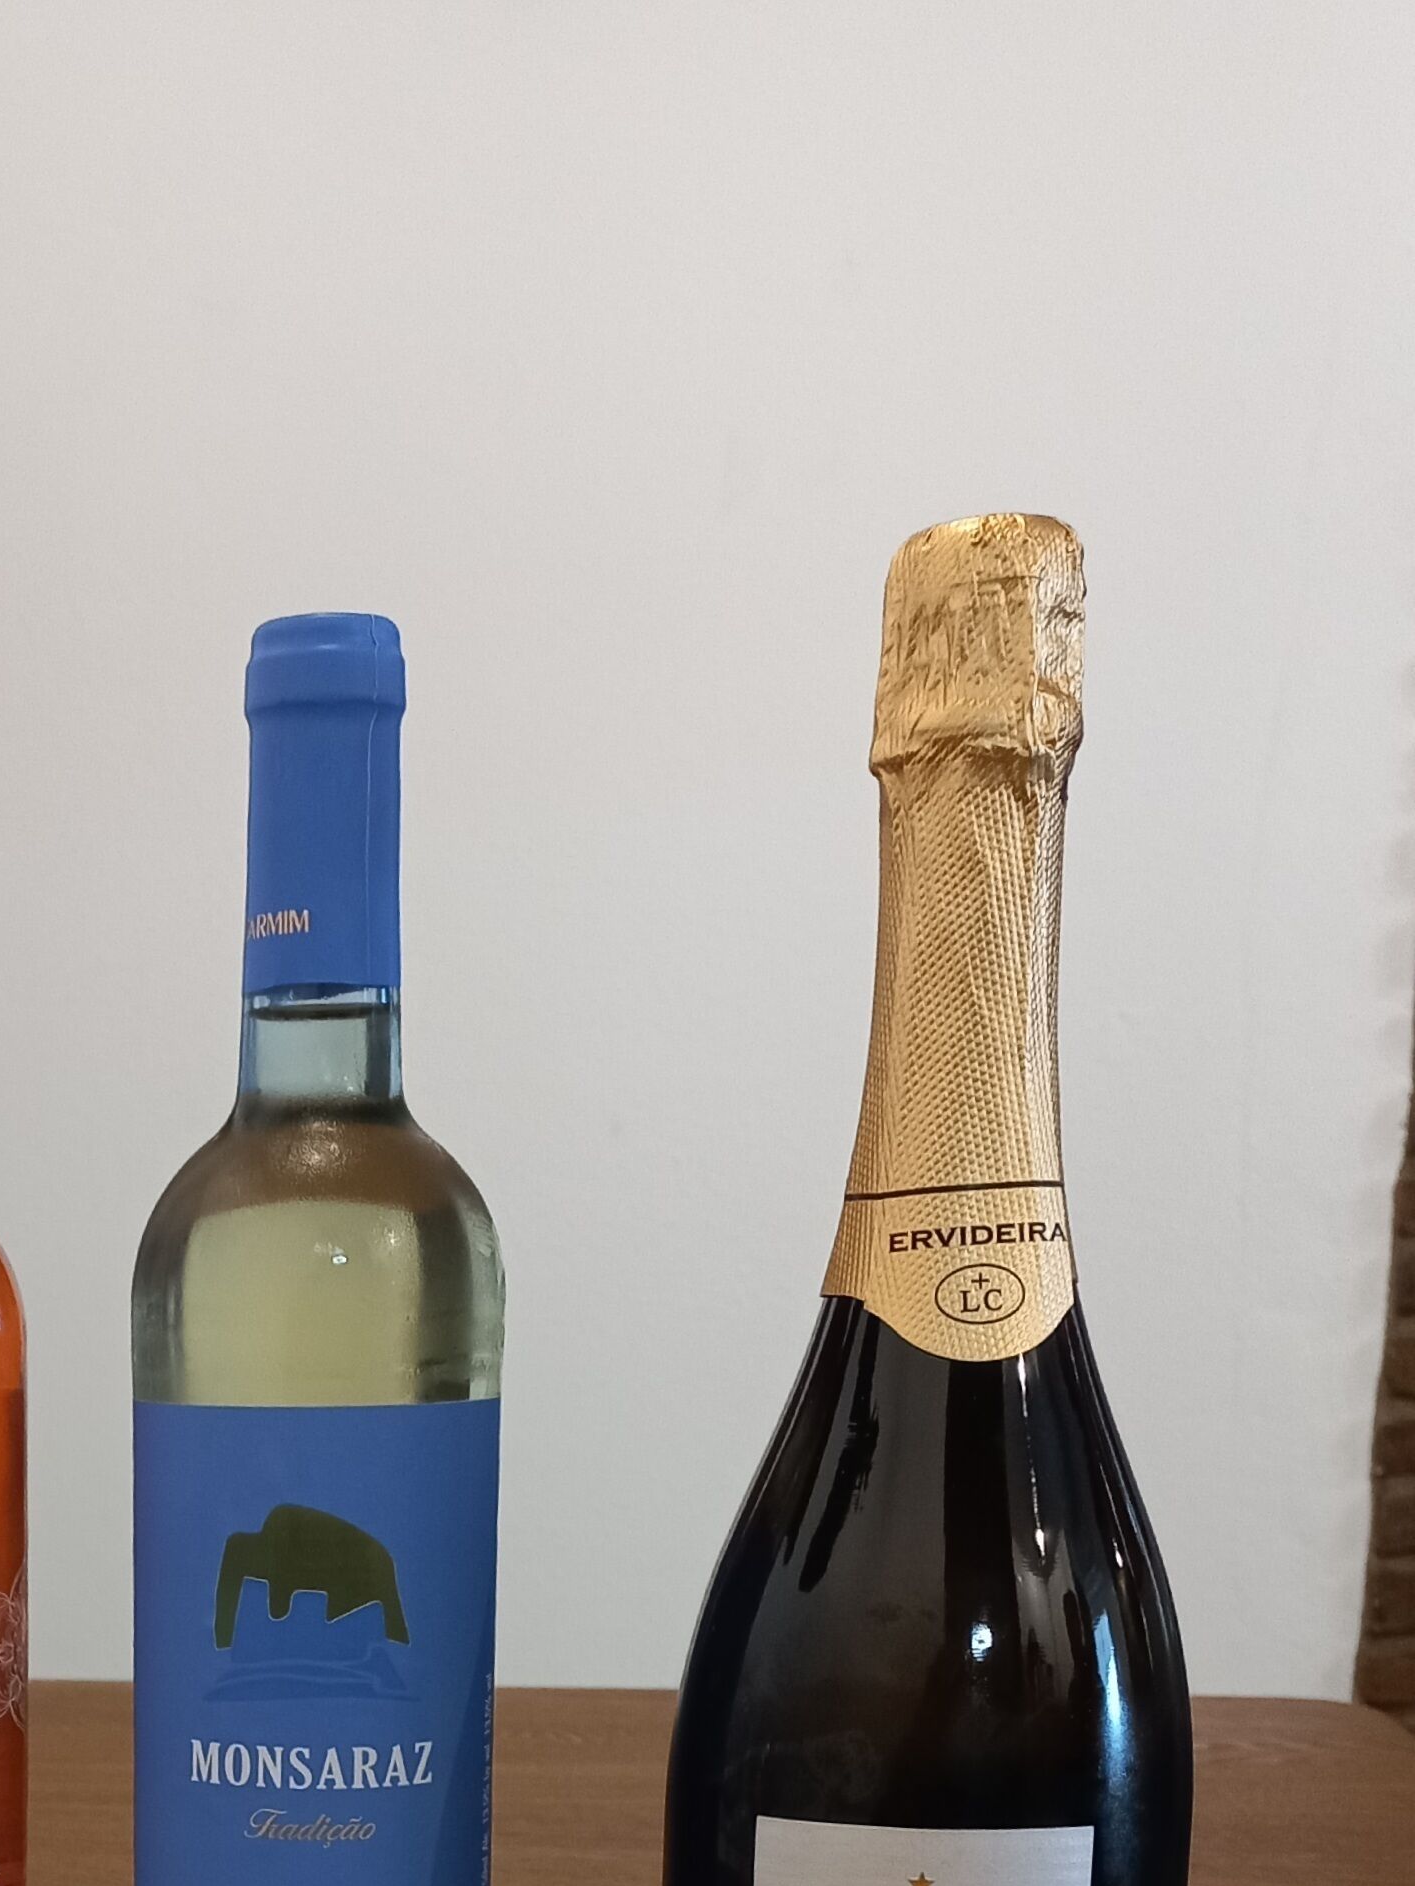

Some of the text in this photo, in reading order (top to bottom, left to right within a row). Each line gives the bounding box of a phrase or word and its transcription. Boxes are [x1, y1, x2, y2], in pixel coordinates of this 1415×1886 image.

[247, 909, 309, 940] ARMIM
[888, 1221, 1067, 1254] ERVIDEIRA
[189, 1738, 435, 1791] MONSARAZ
[243, 1807, 377, 1848] Tradição
